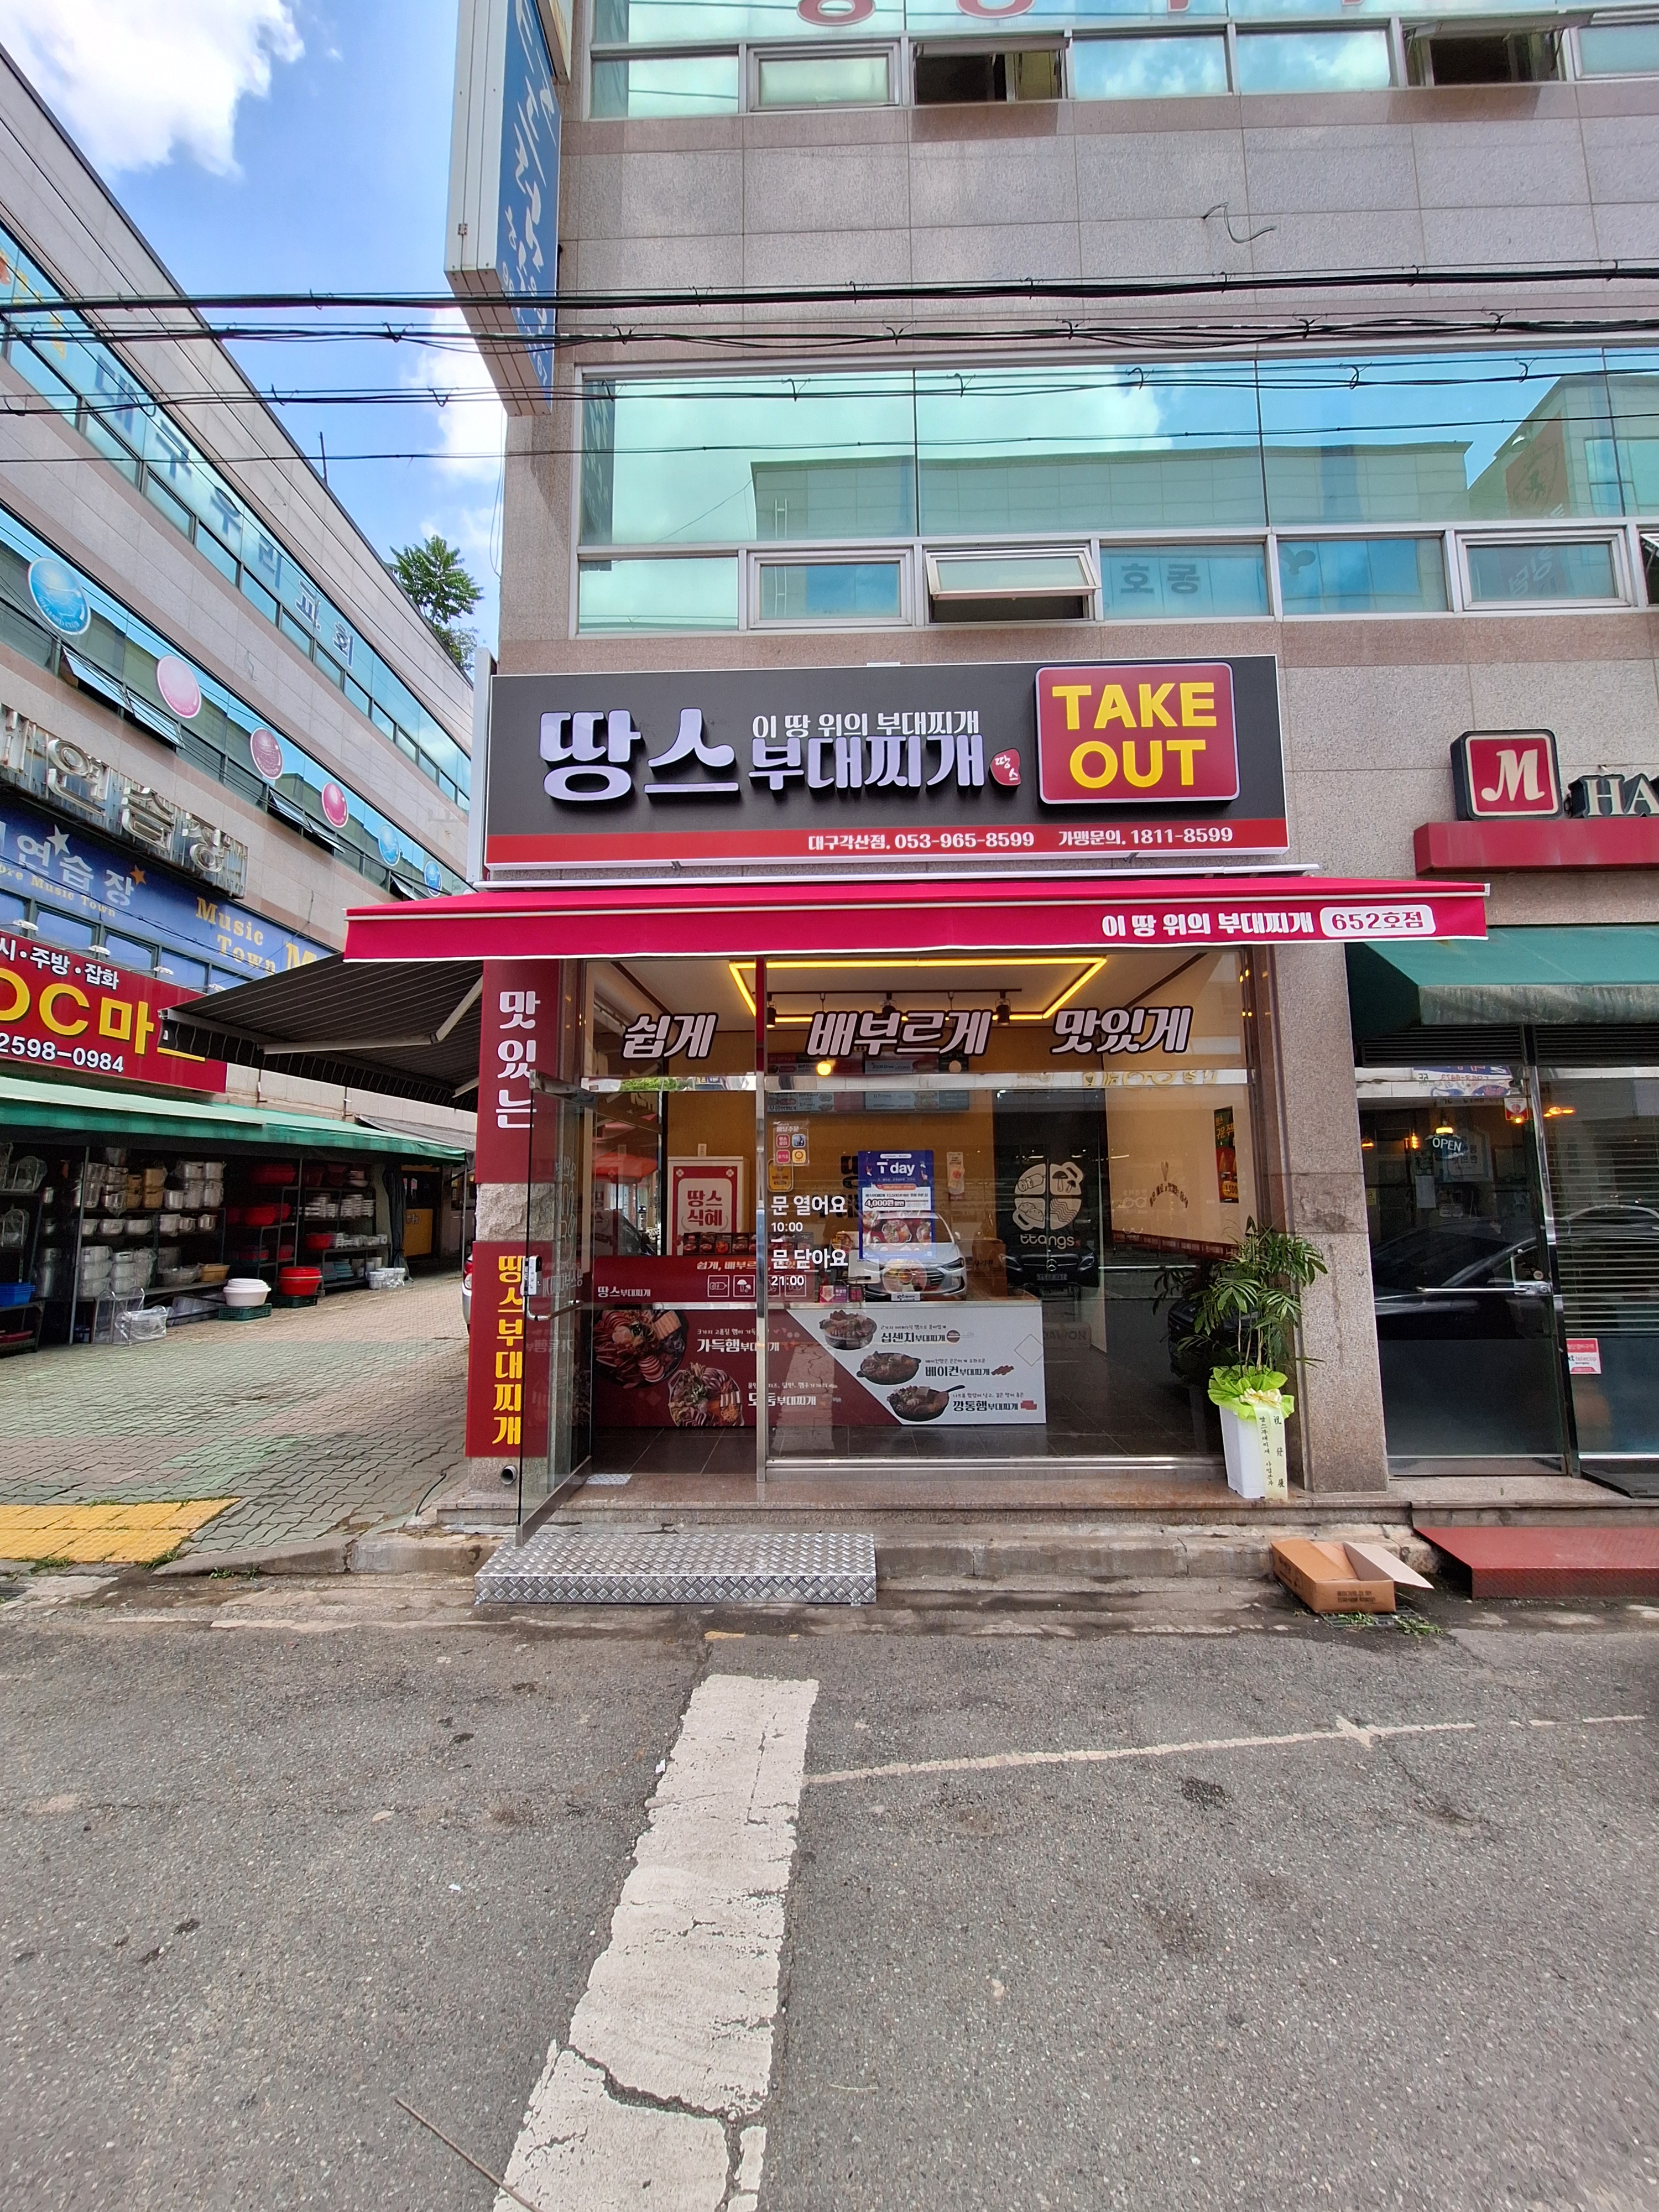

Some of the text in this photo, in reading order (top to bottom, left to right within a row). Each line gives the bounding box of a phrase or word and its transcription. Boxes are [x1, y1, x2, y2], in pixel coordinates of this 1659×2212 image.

[1051, 682, 1217, 731] TAKE
[753, 711, 979, 738] 이 땅 위의 부대찌개
[539, 708, 985, 801] 땅스 부대찌개
[1070, 739, 1206, 789] OUT
[895, 832, 1034, 849] 053-965-8599
[1131, 827, 1233, 844] 1811-8599
[195, 896, 264, 946] Music
[1102, 911, 1423, 937] 이 땅 위의 부대찌개 652호점
[217, 934, 276, 975] Town
[622, 1007, 1193, 1059] 쉽게 배부르게 맛있게
[496, 990, 541, 1129] 맛있는
[1432, 1137, 1463, 1151] OPEN
[890, 1162, 915, 1176] day
[687, 1190, 723, 1207] 땅스
[771, 1195, 848, 1217] 문 열어요
[686, 1209, 723, 1227] 식혜
[771, 1221, 804, 1233] 10:00
[1020, 1234, 1075, 1250] ttangs
[771, 1249, 789, 1269] 문
[794, 1248, 848, 1269] 닫아요
[770, 1275, 805, 1286] 21:00
[597, 1285, 651, 1298] 땅스부대찌개
[925, 1366, 990, 1377] 베이컨부대찌개
[953, 1400, 1018, 1412] 깡통햄부대찌개
